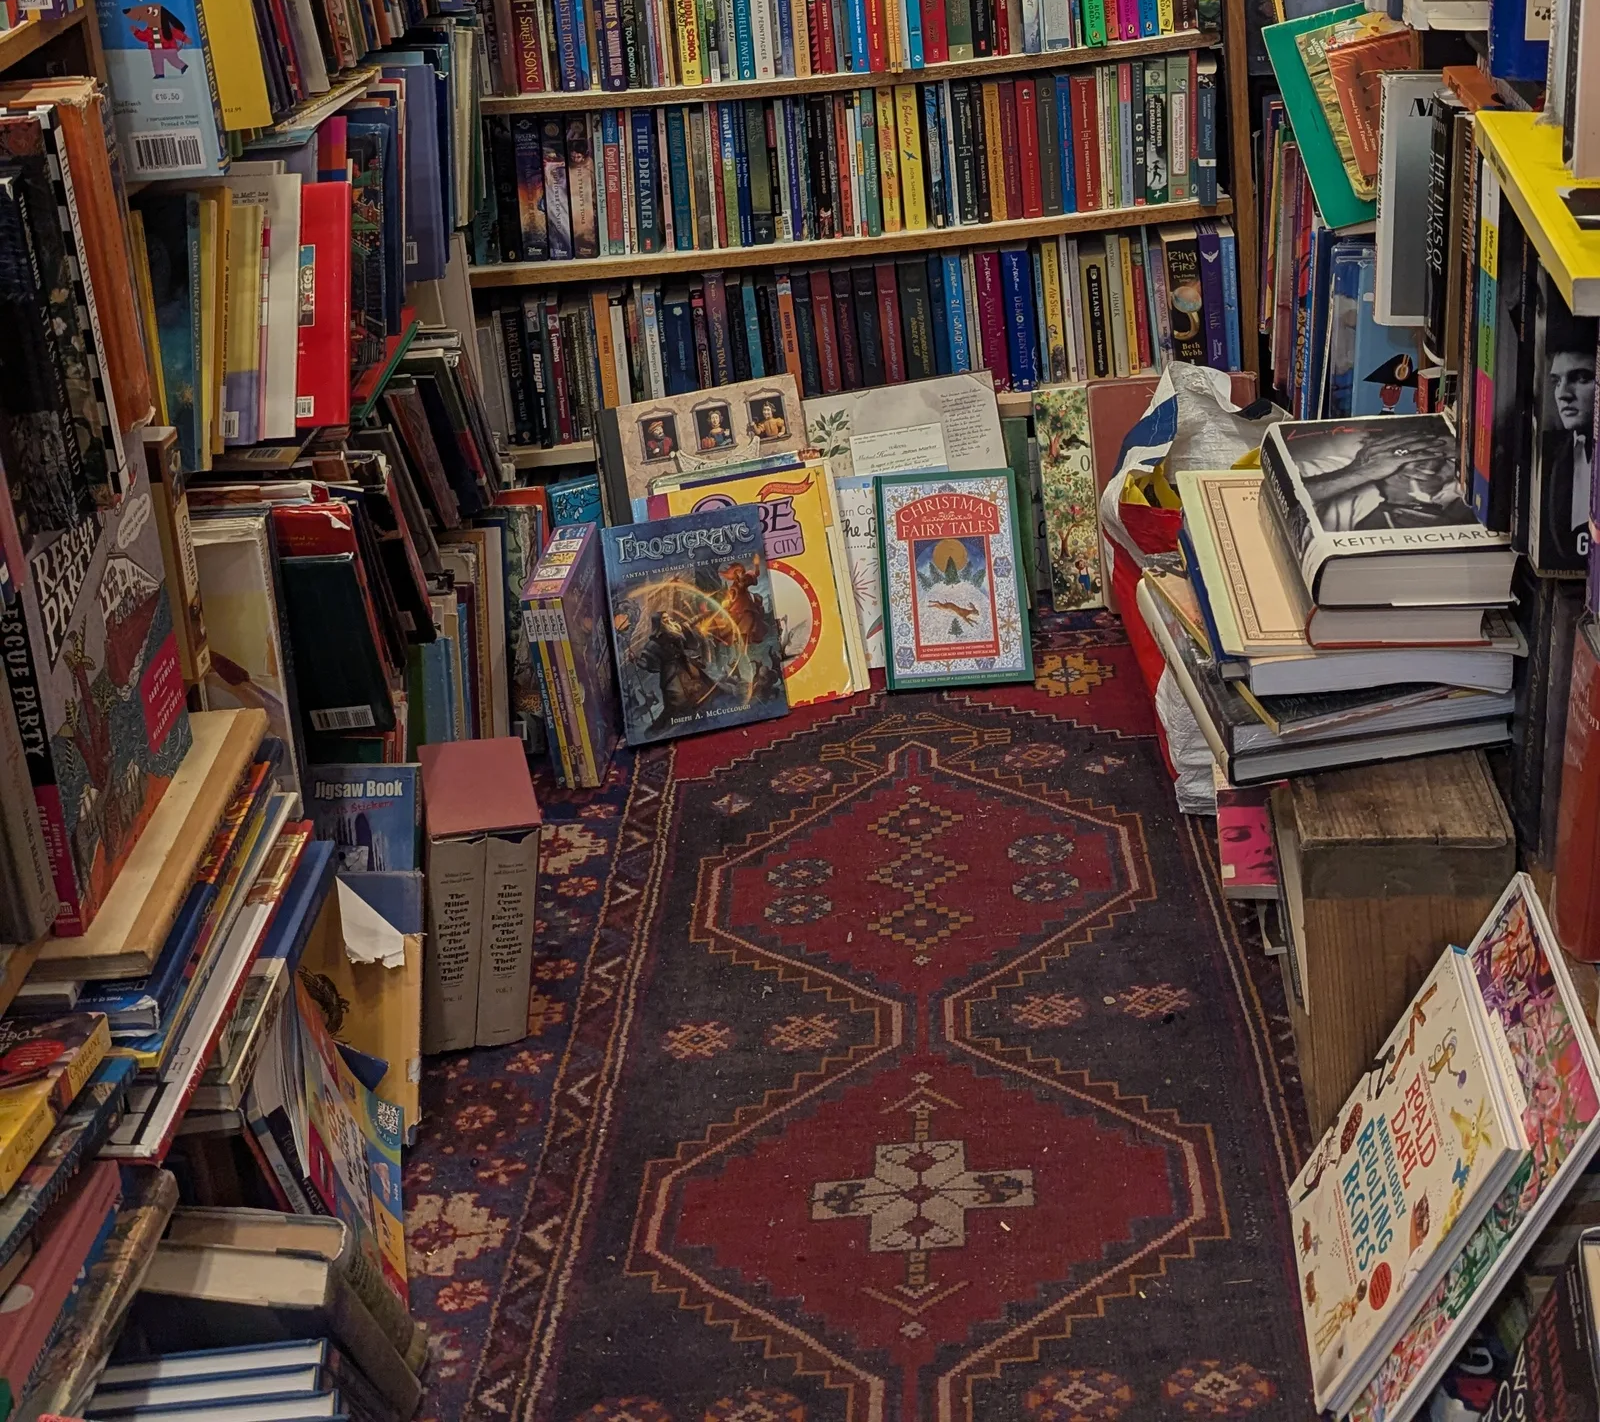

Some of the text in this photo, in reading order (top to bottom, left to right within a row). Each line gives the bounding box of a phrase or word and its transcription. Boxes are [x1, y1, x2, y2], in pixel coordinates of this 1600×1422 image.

[520, 17, 538, 83] SIREN SONG
[688, 26, 697, 63] SCHOOL
[729, 31, 735, 42] Us
[740, 35, 749, 67] PAVER
[758, 16, 767, 60] PENNYPACKER
[564, 32, 576, 84] MONDAY
[1135, 113, 1144, 166] LOSER
[636, 126, 652, 229] THE DREAMER
[1433, 153, 1445, 275] THE LIVES OF
[1091, 282, 1101, 318] ELFLAND
[1111, 291, 1120, 318] AHMEK
[90, 312, 108, 375] GOOSE
[1013, 295, 1028, 370] DEMON DENTIST
[1182, 342, 1201, 350] Beth
[532, 353, 545, 393] Dougal
[900, 496, 995, 523] CHRISTMAS
[902, 520, 995, 538] FAIRY TALES
[33, 517, 95, 605] RESCUE
[774, 538, 799, 555] CITY
[1333, 536, 1396, 548] KEITH
[622, 571, 649, 579] FANTASY
[652, 564, 685, 574] WARGAMES
[711, 556, 736, 564] FROZEN
[43, 537, 96, 662] PARTY!
[14, 685, 44, 758] PARTY
[315, 779, 403, 799] Jigsaw Book
[491, 913, 523, 921] Encyclo
[497, 898, 521, 906] Cross
[493, 964, 517, 972] Music
[1405, 1073, 1436, 1167] ROALD
[1377, 1113, 1407, 1219] MARVELLOUSLY
[1391, 1103, 1418, 1190] DAHL
[1357, 1117, 1393, 1254] REVOLTING
[1342, 1159, 1376, 1272] RECIPES
